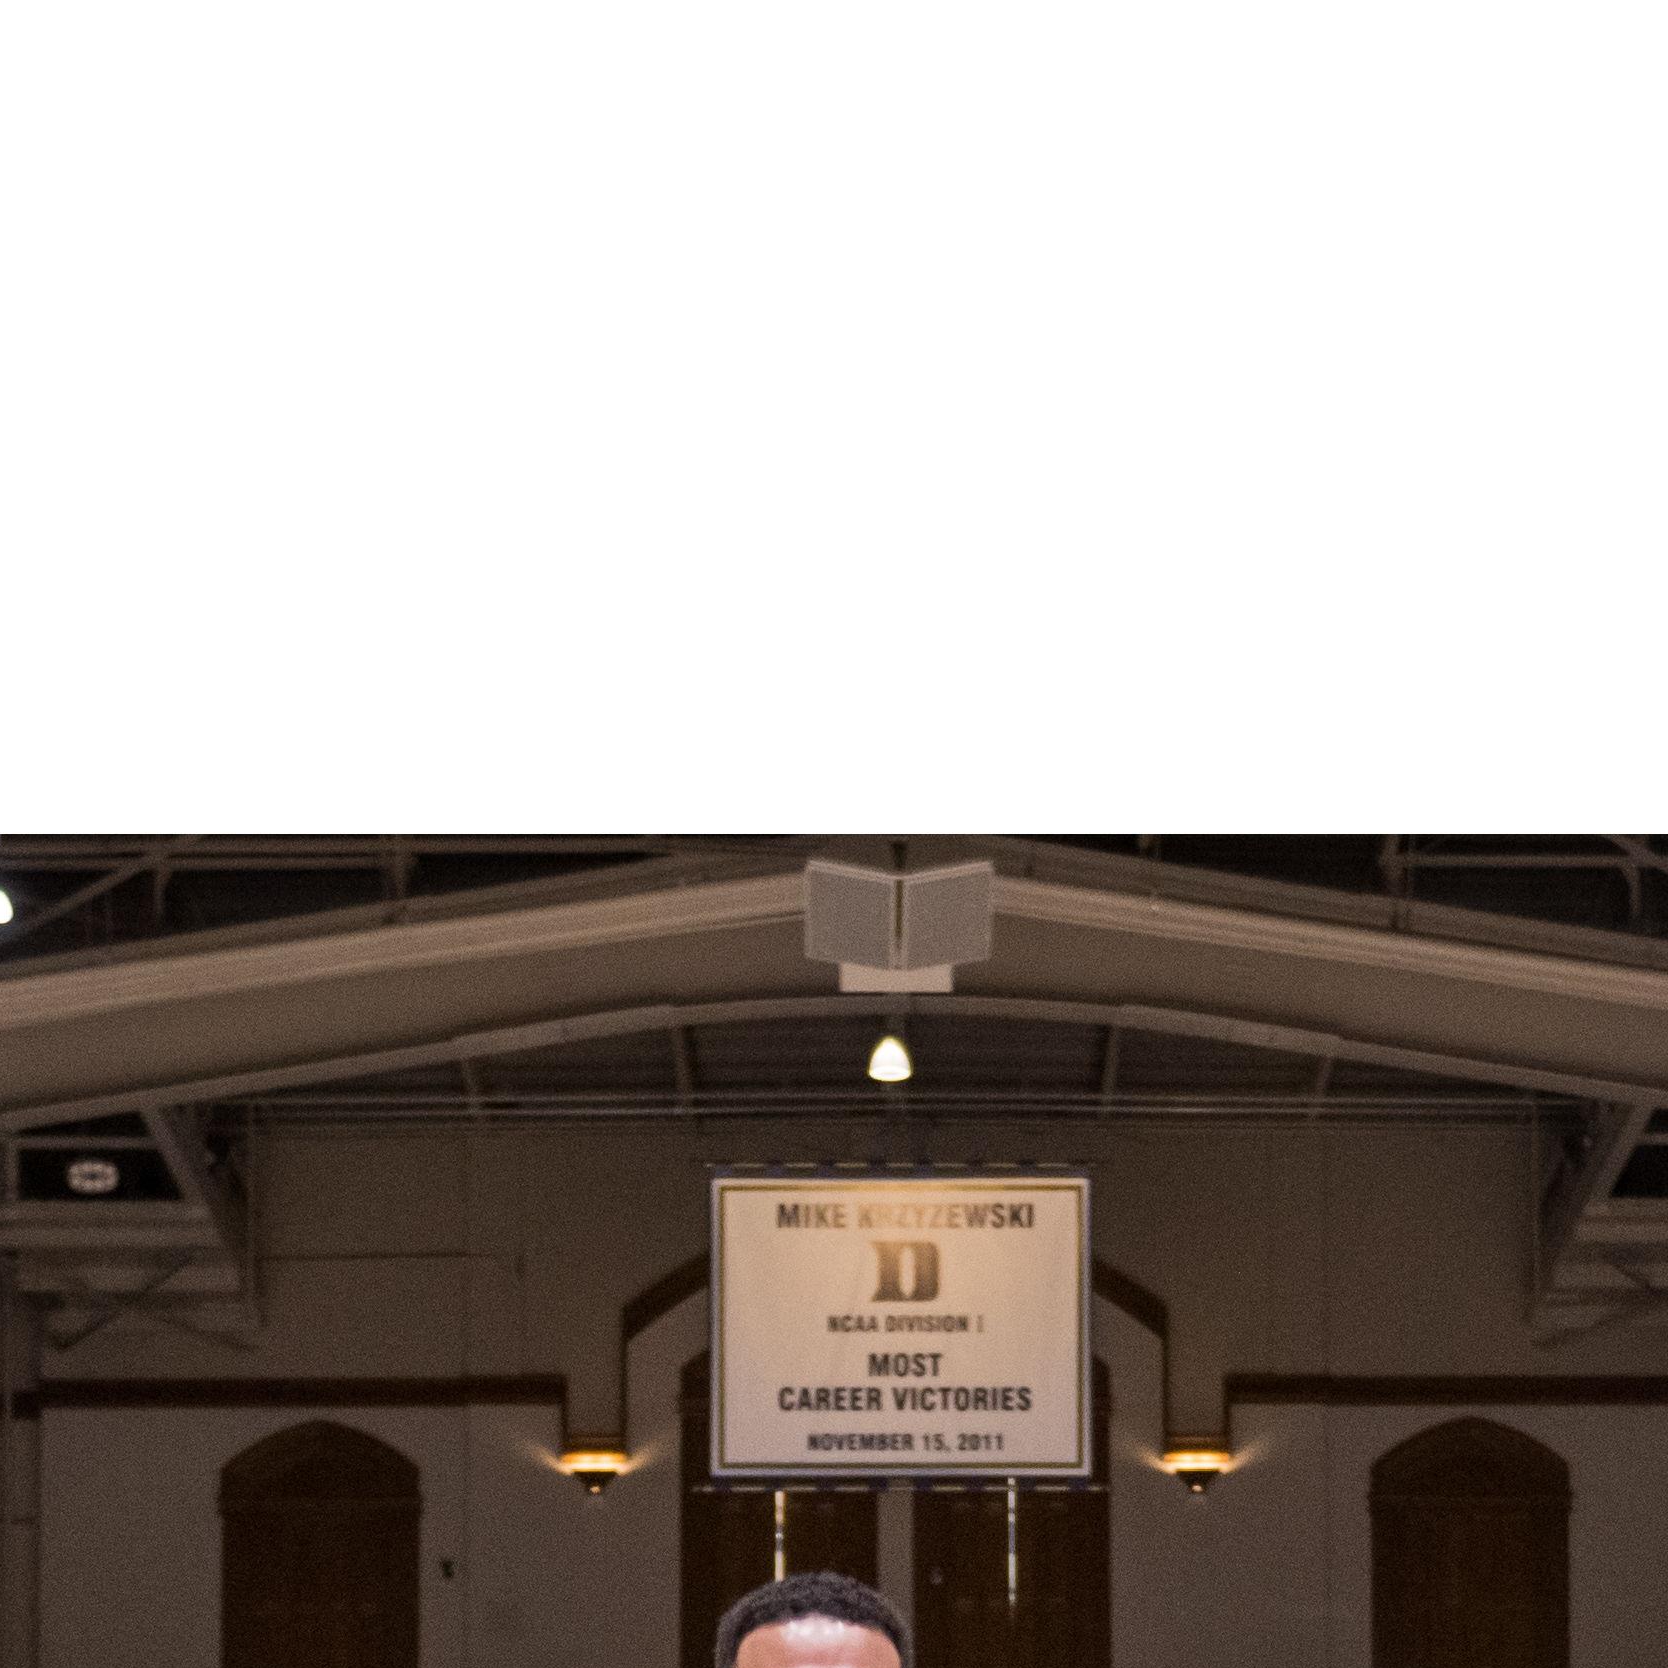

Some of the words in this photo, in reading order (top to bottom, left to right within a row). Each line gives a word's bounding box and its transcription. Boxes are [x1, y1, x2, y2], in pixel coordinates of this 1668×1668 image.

[777, 1202, 847, 1230] MIKE
[827, 1314, 879, 1334] NCAA
[884, 1314, 969, 1334] DIVISION
[867, 1352, 943, 1378] MOST
[778, 1385, 884, 1412] CAREER
[892, 1385, 1033, 1412] VICTORIES
[807, 1432, 913, 1452] NOVEMBER
[922, 1432, 952, 1453] 15,
[957, 1432, 1005, 1452] 2011
